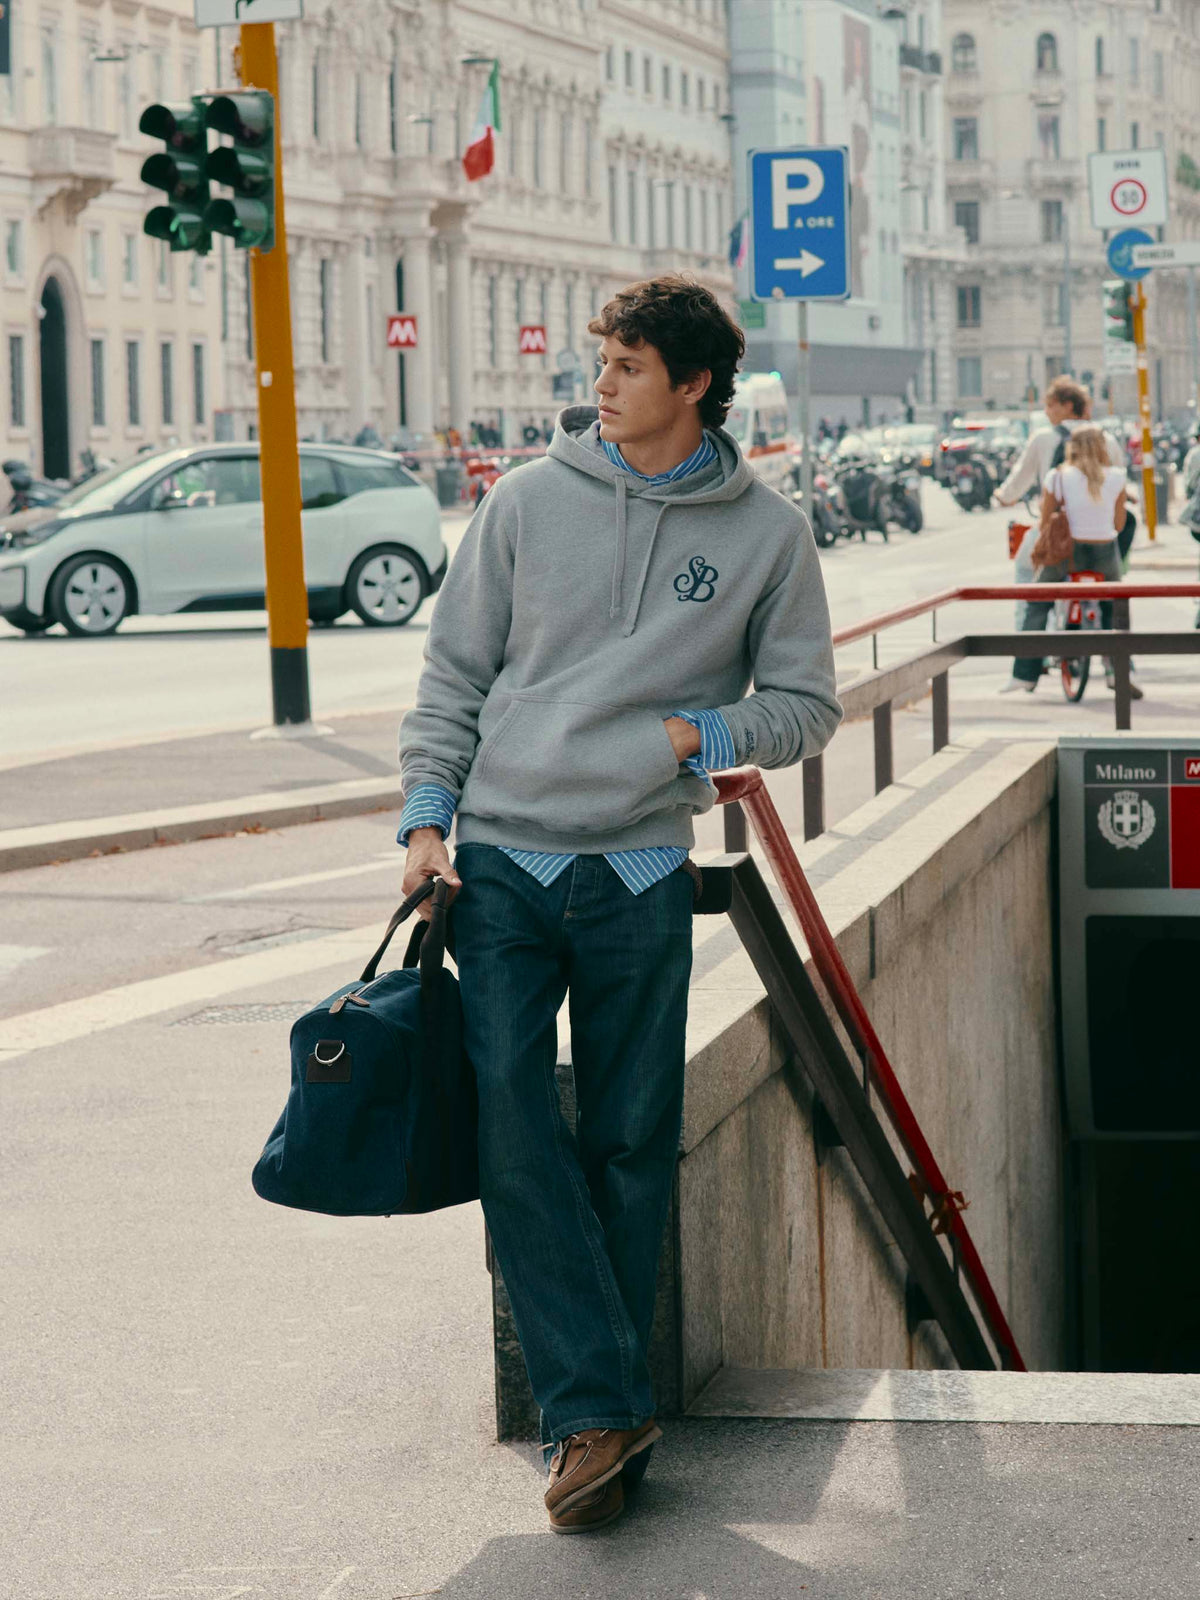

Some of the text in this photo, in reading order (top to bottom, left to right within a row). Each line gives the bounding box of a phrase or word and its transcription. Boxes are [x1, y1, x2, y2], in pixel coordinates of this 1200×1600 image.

[772, 158, 824, 229] P
[794, 217, 804, 228] A
[387, 320, 417, 343] M
[520, 329, 545, 350] M
[673, 555, 719, 602] SB
[1096, 764, 1156, 780] Milano
